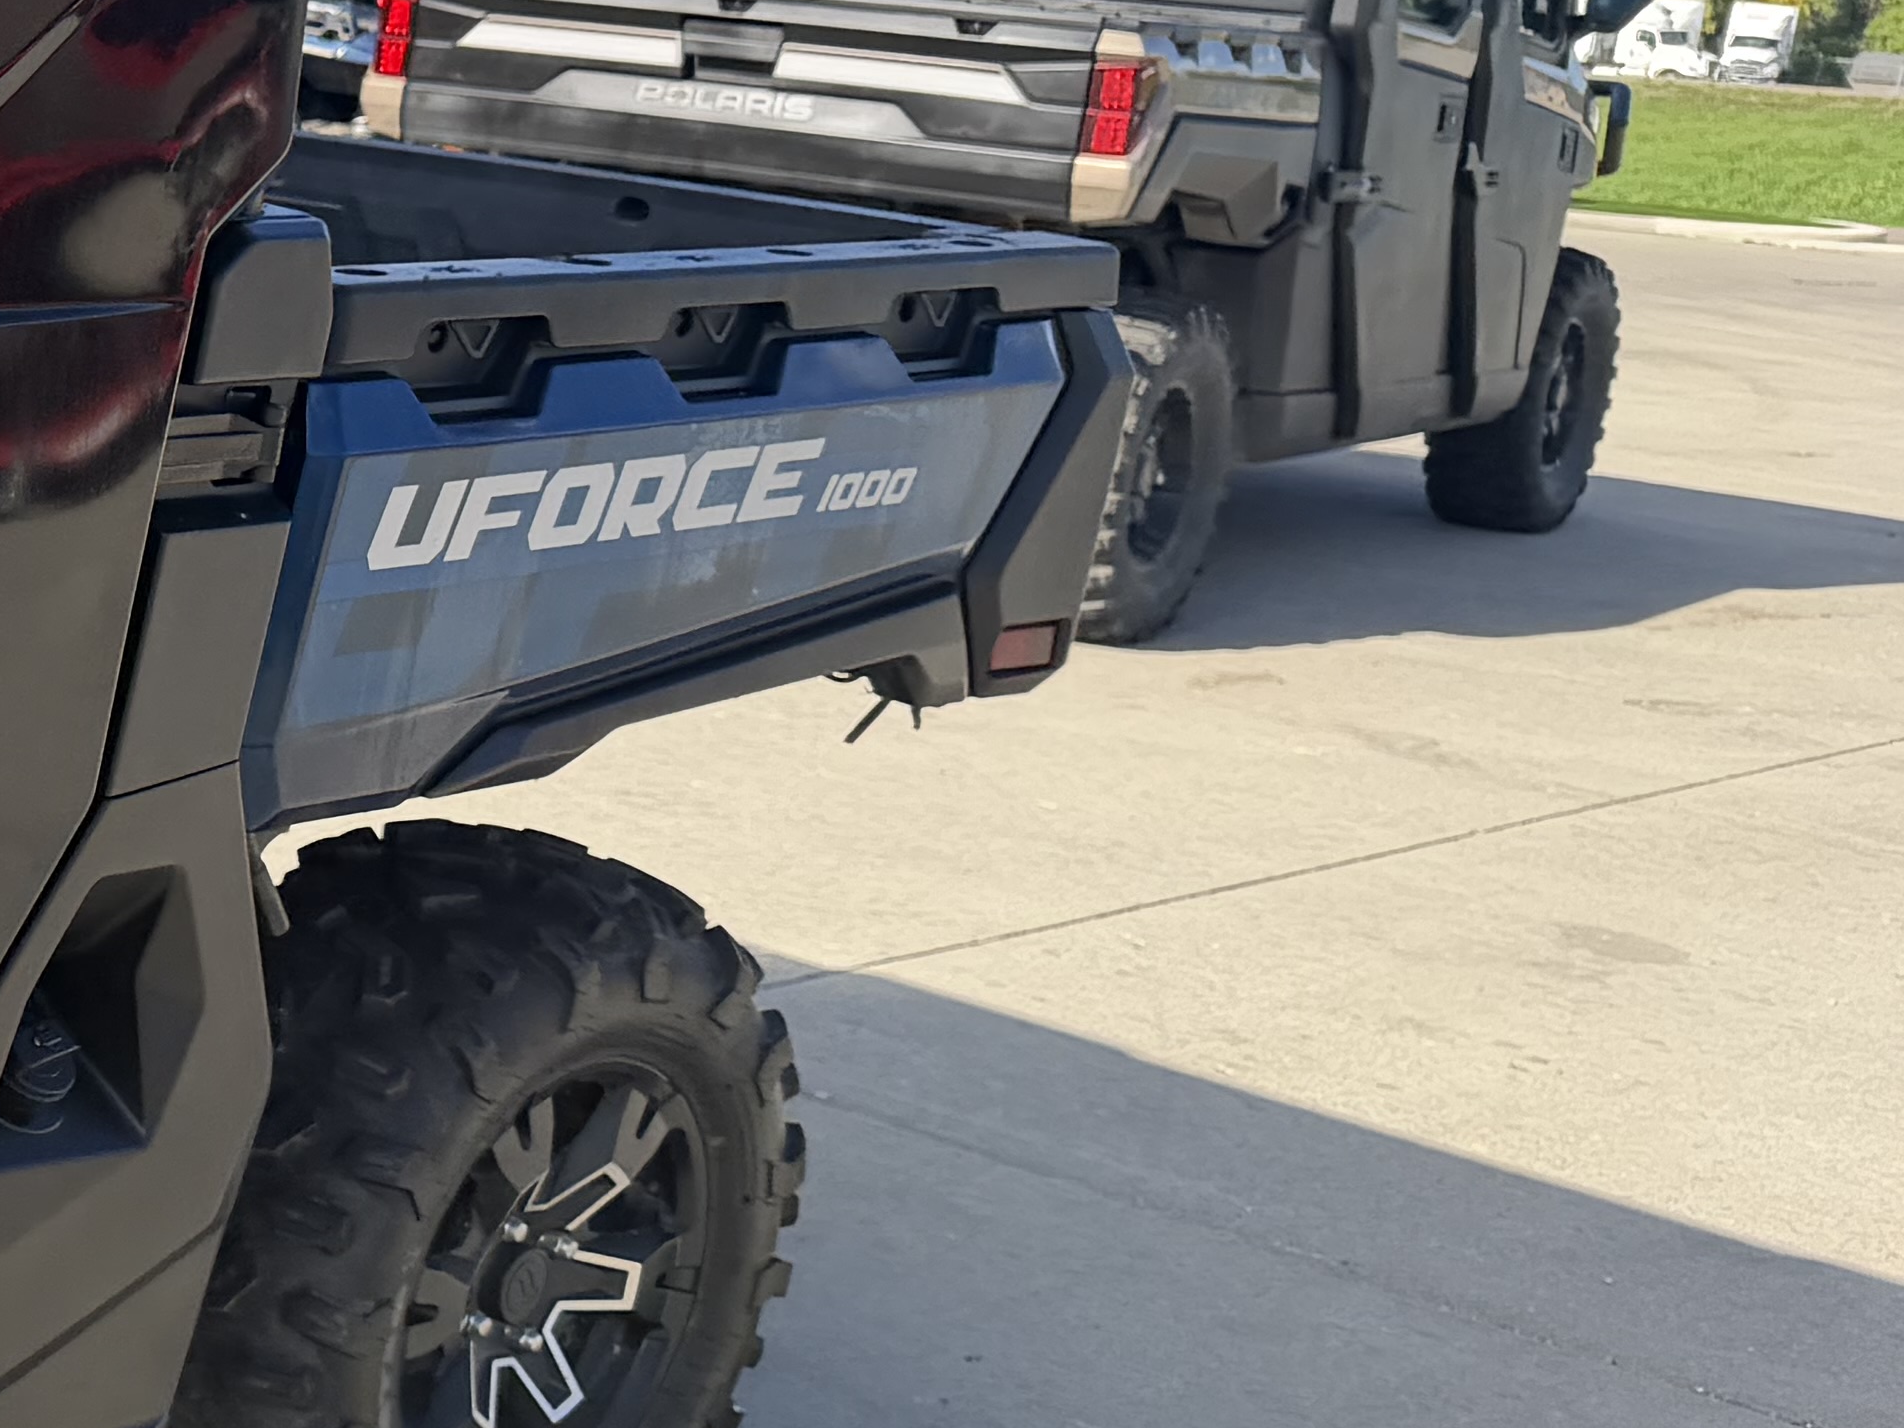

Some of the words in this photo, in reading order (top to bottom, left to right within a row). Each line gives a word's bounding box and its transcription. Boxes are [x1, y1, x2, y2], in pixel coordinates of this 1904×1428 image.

[635, 79, 815, 122] POLARIS
[367, 438, 826, 571] UFORCE
[817, 467, 917, 513] 1000
